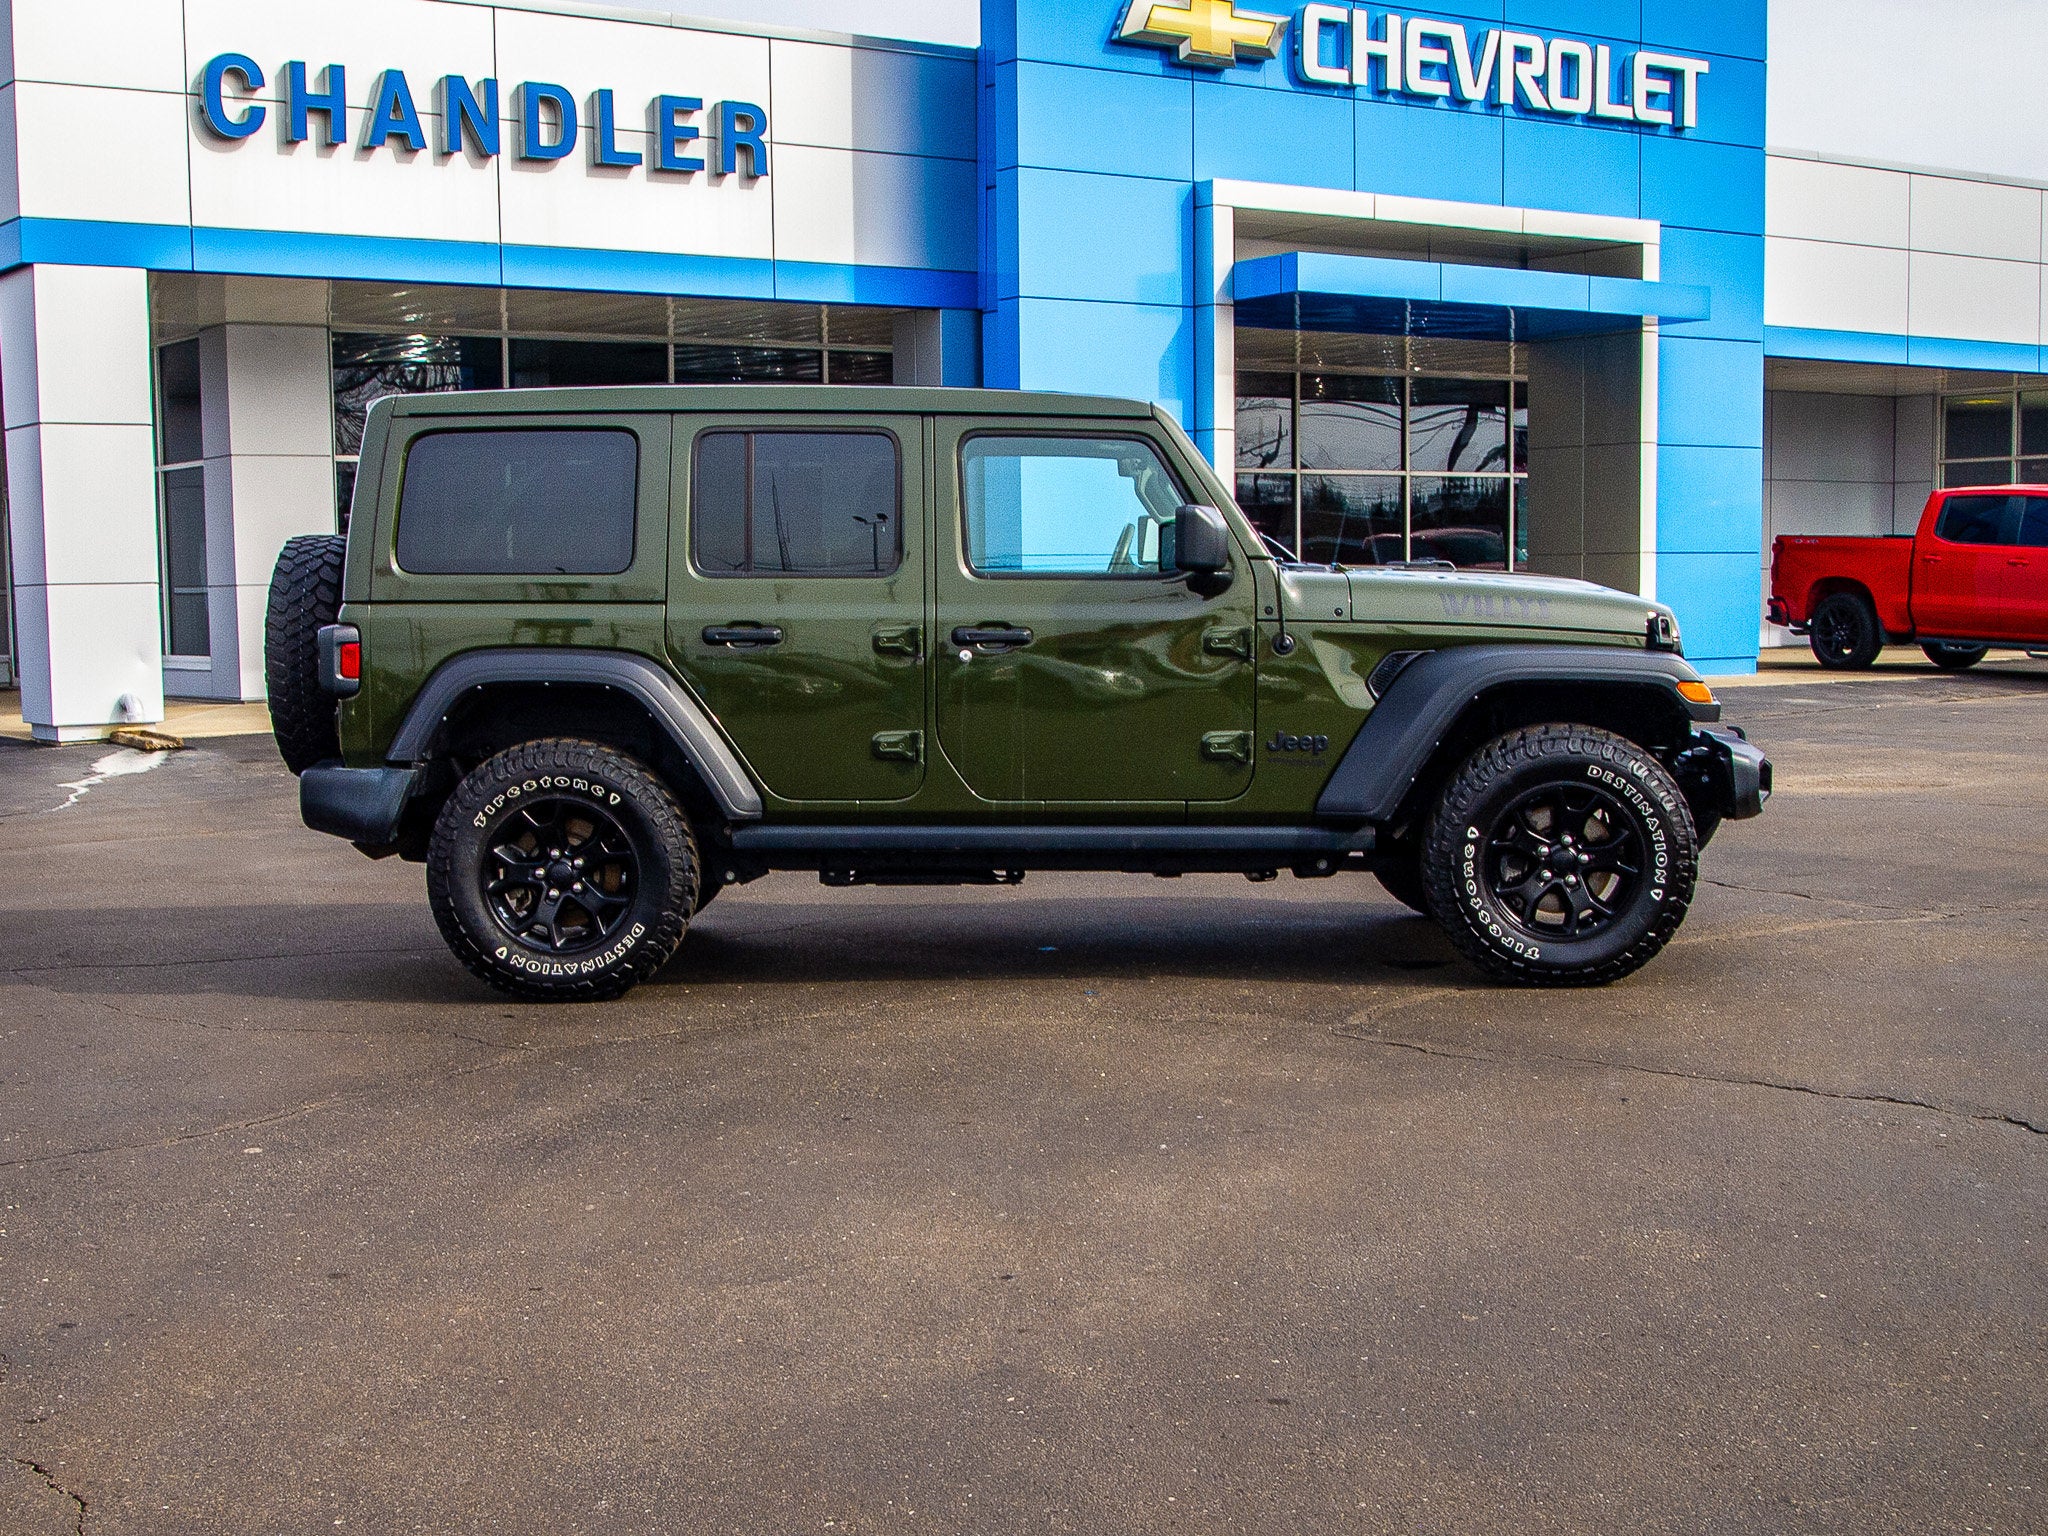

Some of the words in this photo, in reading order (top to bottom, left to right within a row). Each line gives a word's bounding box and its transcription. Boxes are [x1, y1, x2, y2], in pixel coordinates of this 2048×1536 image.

[1297, 4, 1710, 129] CHEVROLET
[199, 53, 770, 178] CHANDLER
[1267, 730, 1329, 755] Jeep
[474, 775, 605, 828] Firestone
[1587, 765, 1668, 884] DESTINATION
[510, 922, 646, 975] DESTINATION
